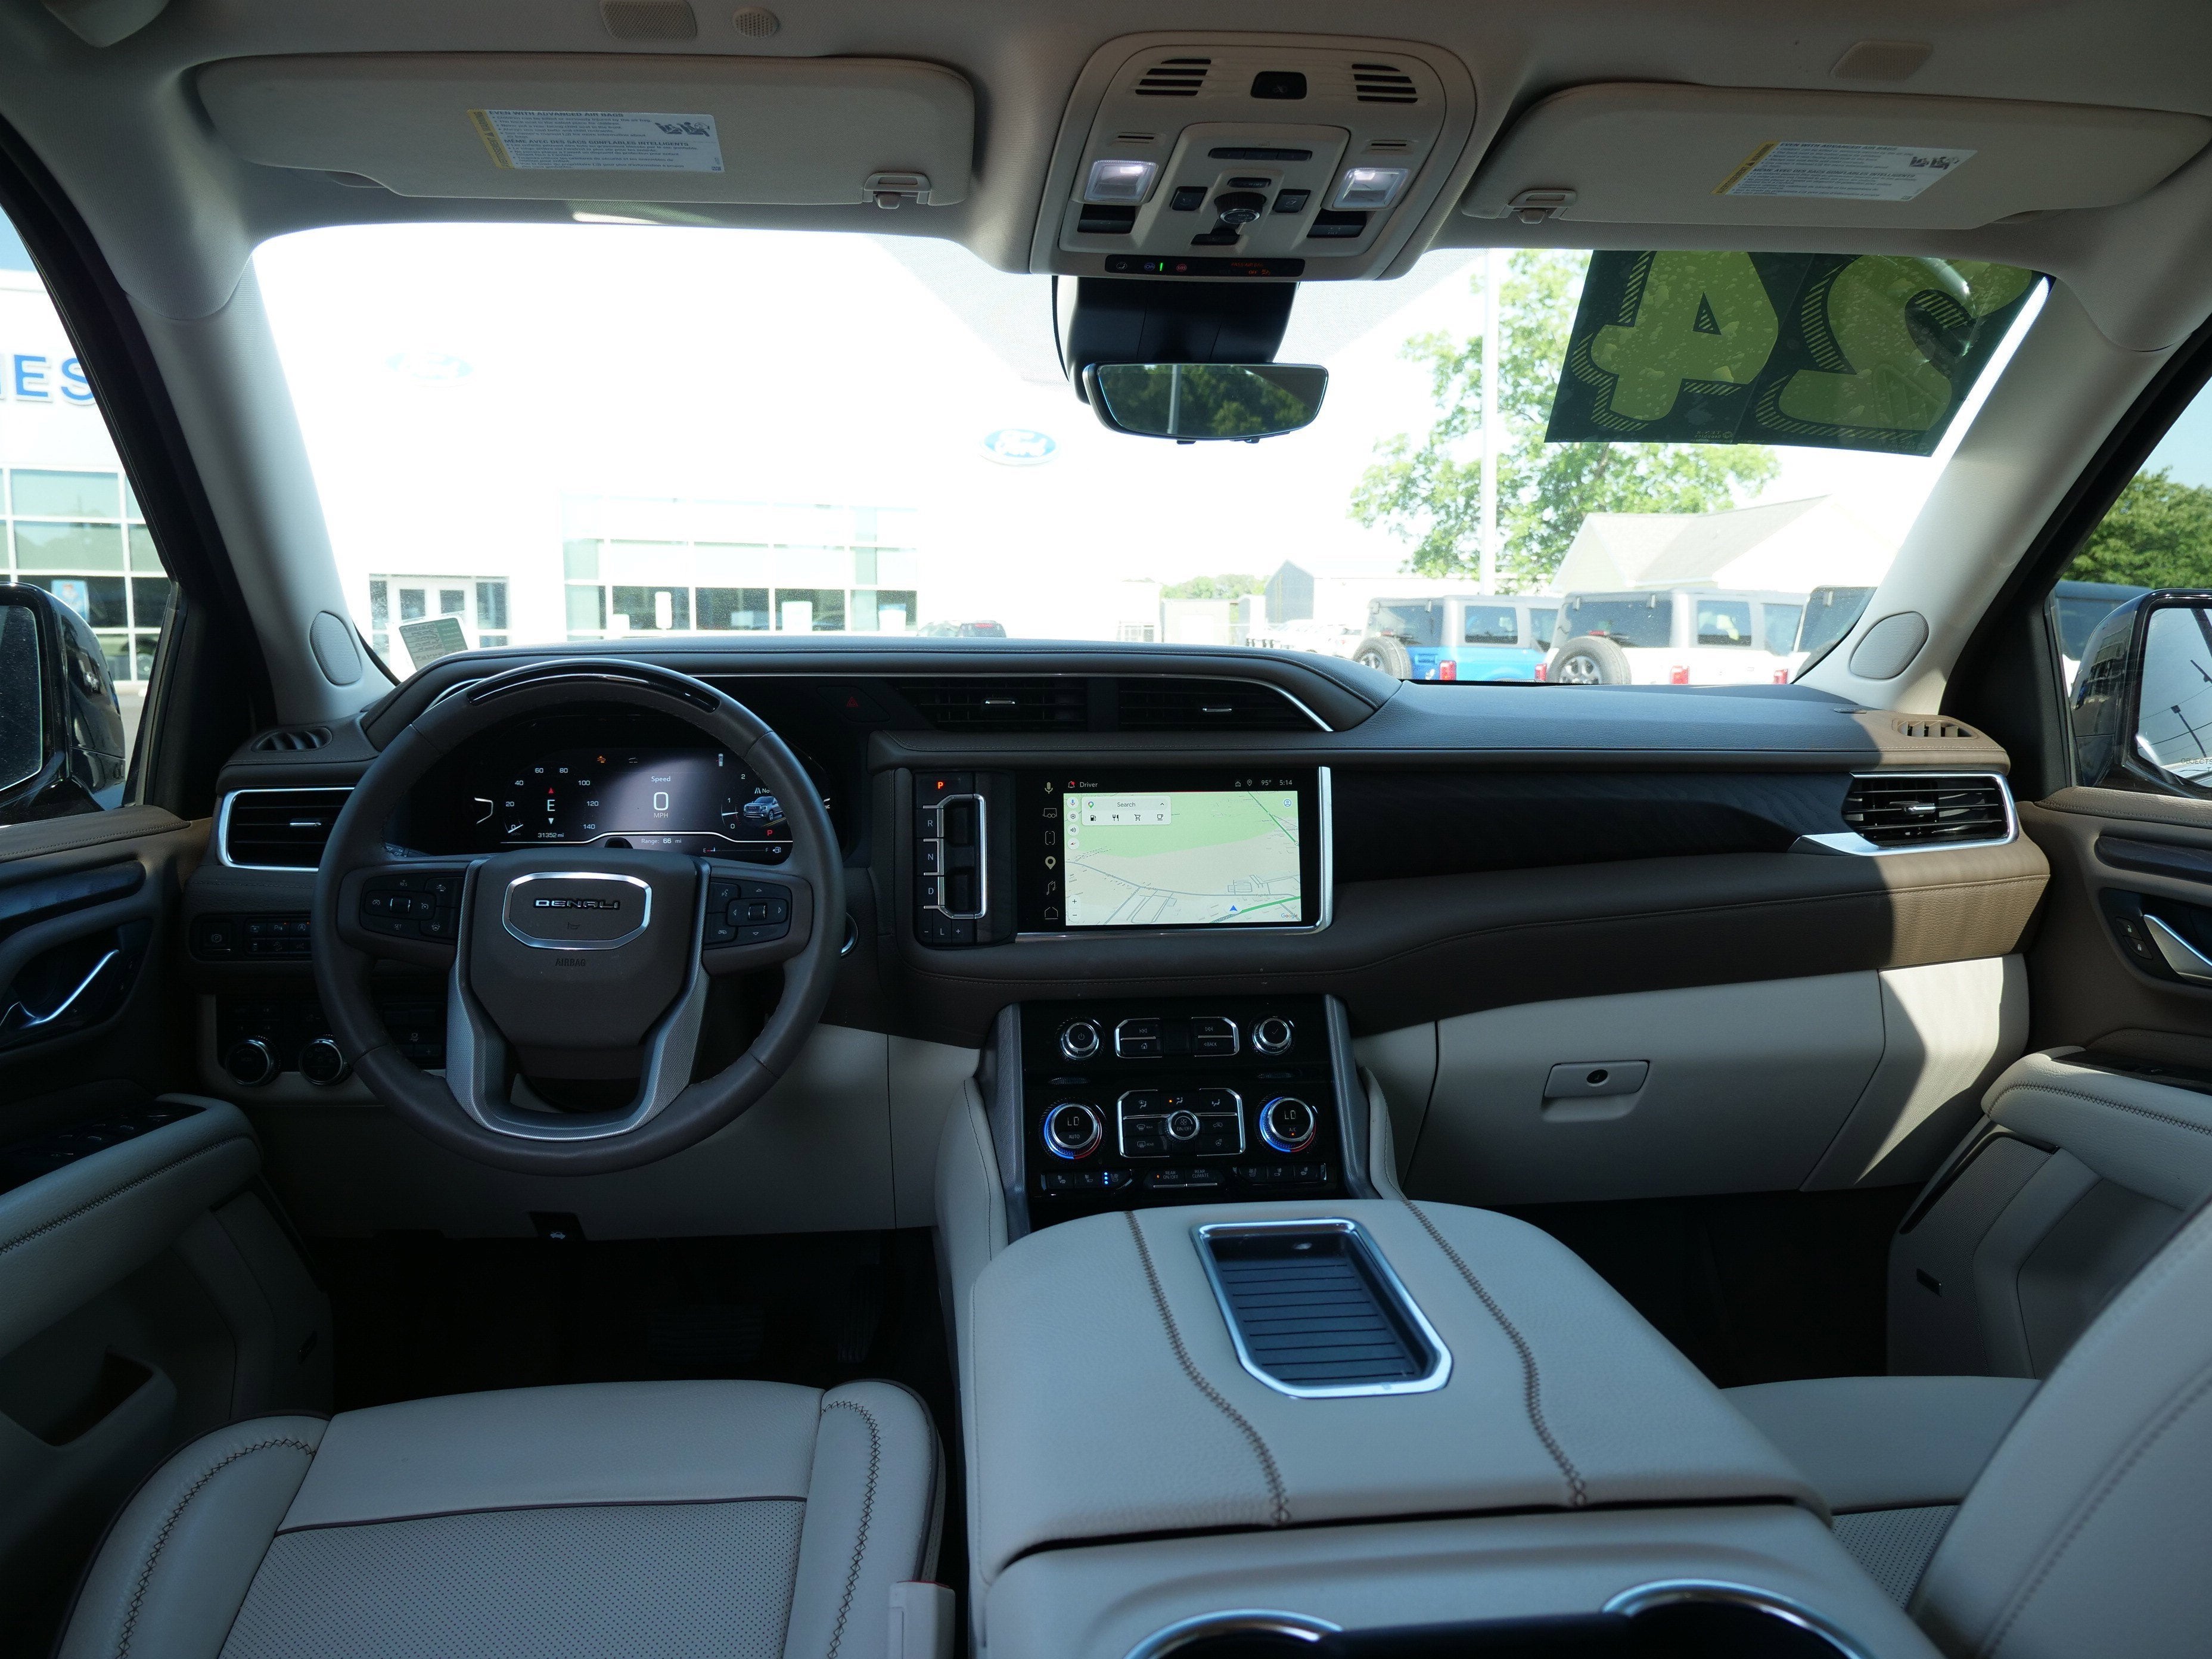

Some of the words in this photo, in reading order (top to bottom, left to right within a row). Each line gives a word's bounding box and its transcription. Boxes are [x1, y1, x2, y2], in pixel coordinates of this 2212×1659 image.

[547, 799, 555, 812] E
[535, 899, 619, 910] DENALI
[555, 958, 586, 967] AIRBAG
